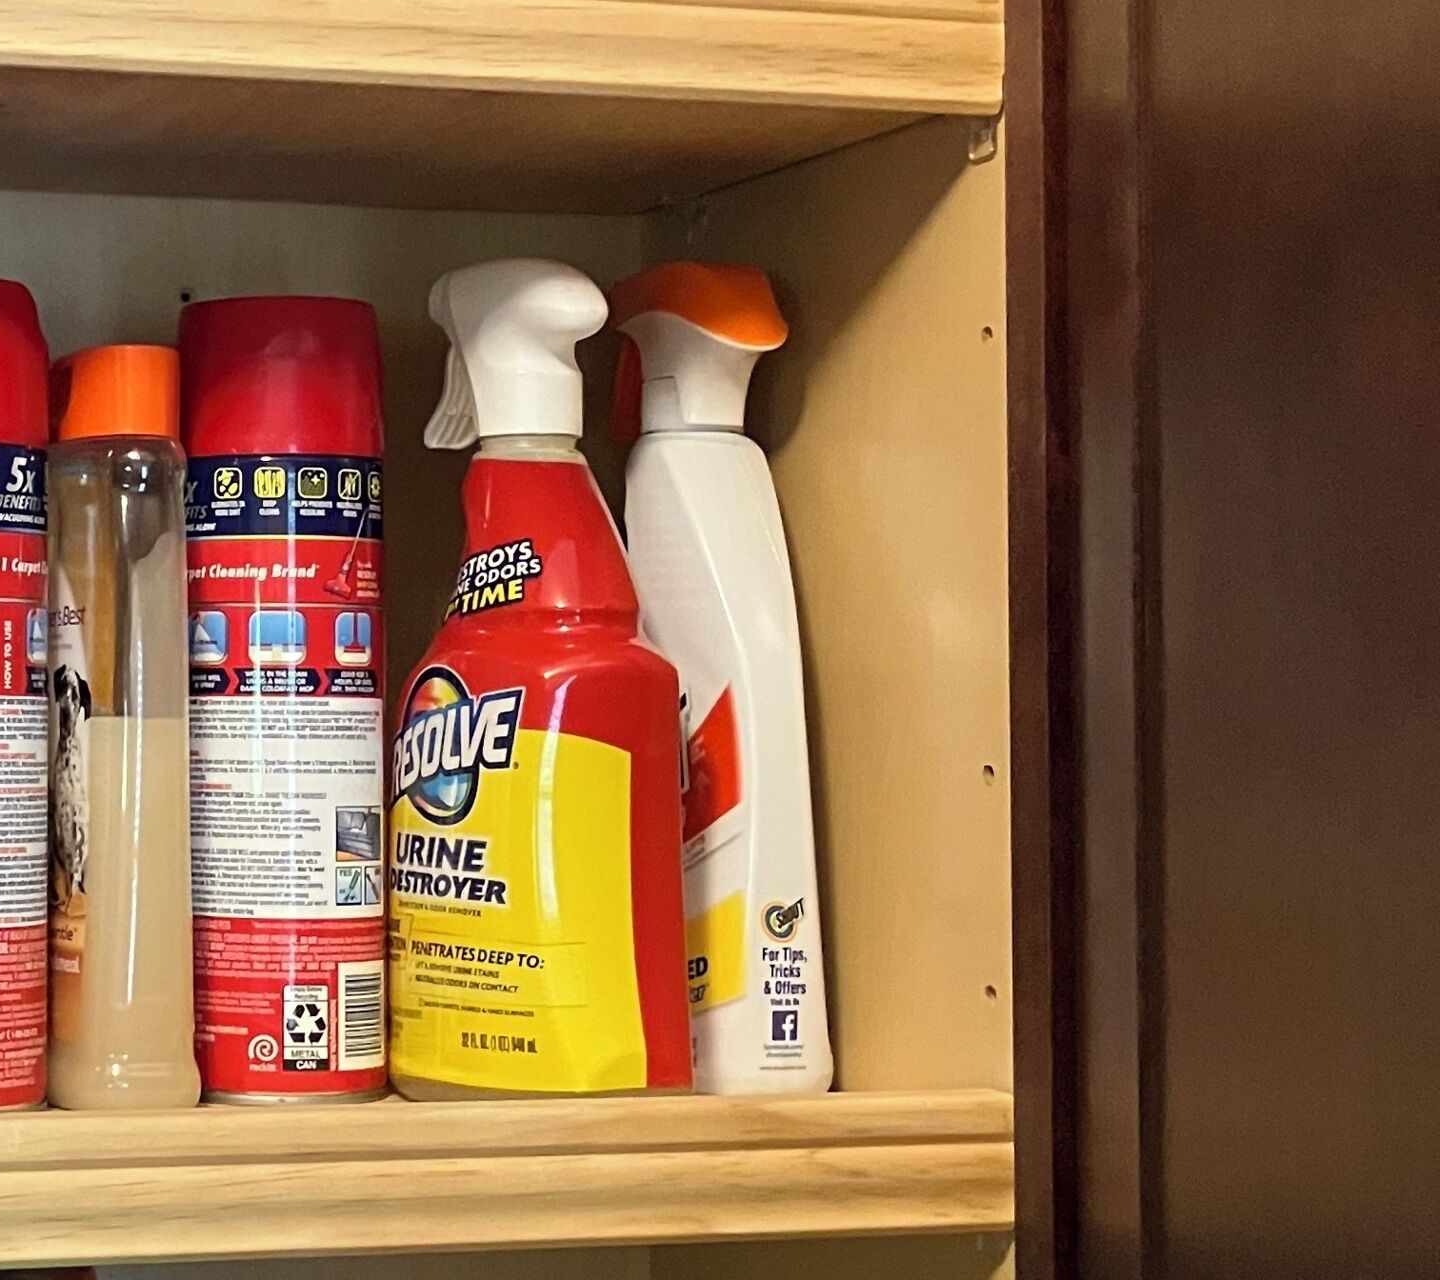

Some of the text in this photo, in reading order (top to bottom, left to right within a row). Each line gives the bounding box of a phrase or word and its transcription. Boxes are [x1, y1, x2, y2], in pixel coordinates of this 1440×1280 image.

[209, 564, 267, 581] Cleaning
[271, 563, 315, 578] Brand
[474, 558, 542, 588] ODORS
[462, 578, 523, 613] TIME
[3, 642, 13, 658] TO
[3, 660, 13, 690] HOW
[389, 696, 517, 800] RESOLVE
[396, 831, 488, 872] URINE
[390, 868, 507, 905] DESTROYER
[411, 940, 475, 963] PENETRATES
[477, 948, 514, 966] DEEP
[516, 953, 546, 970] TO:
[762, 947, 808, 963] For Tips,
[769, 964, 801, 978] Tricks
[481, 983, 519, 993] CONTACT
[763, 981, 807, 995] & Offers
[291, 1050, 320, 1058] METAL
[296, 1060, 317, 1070] CAN
